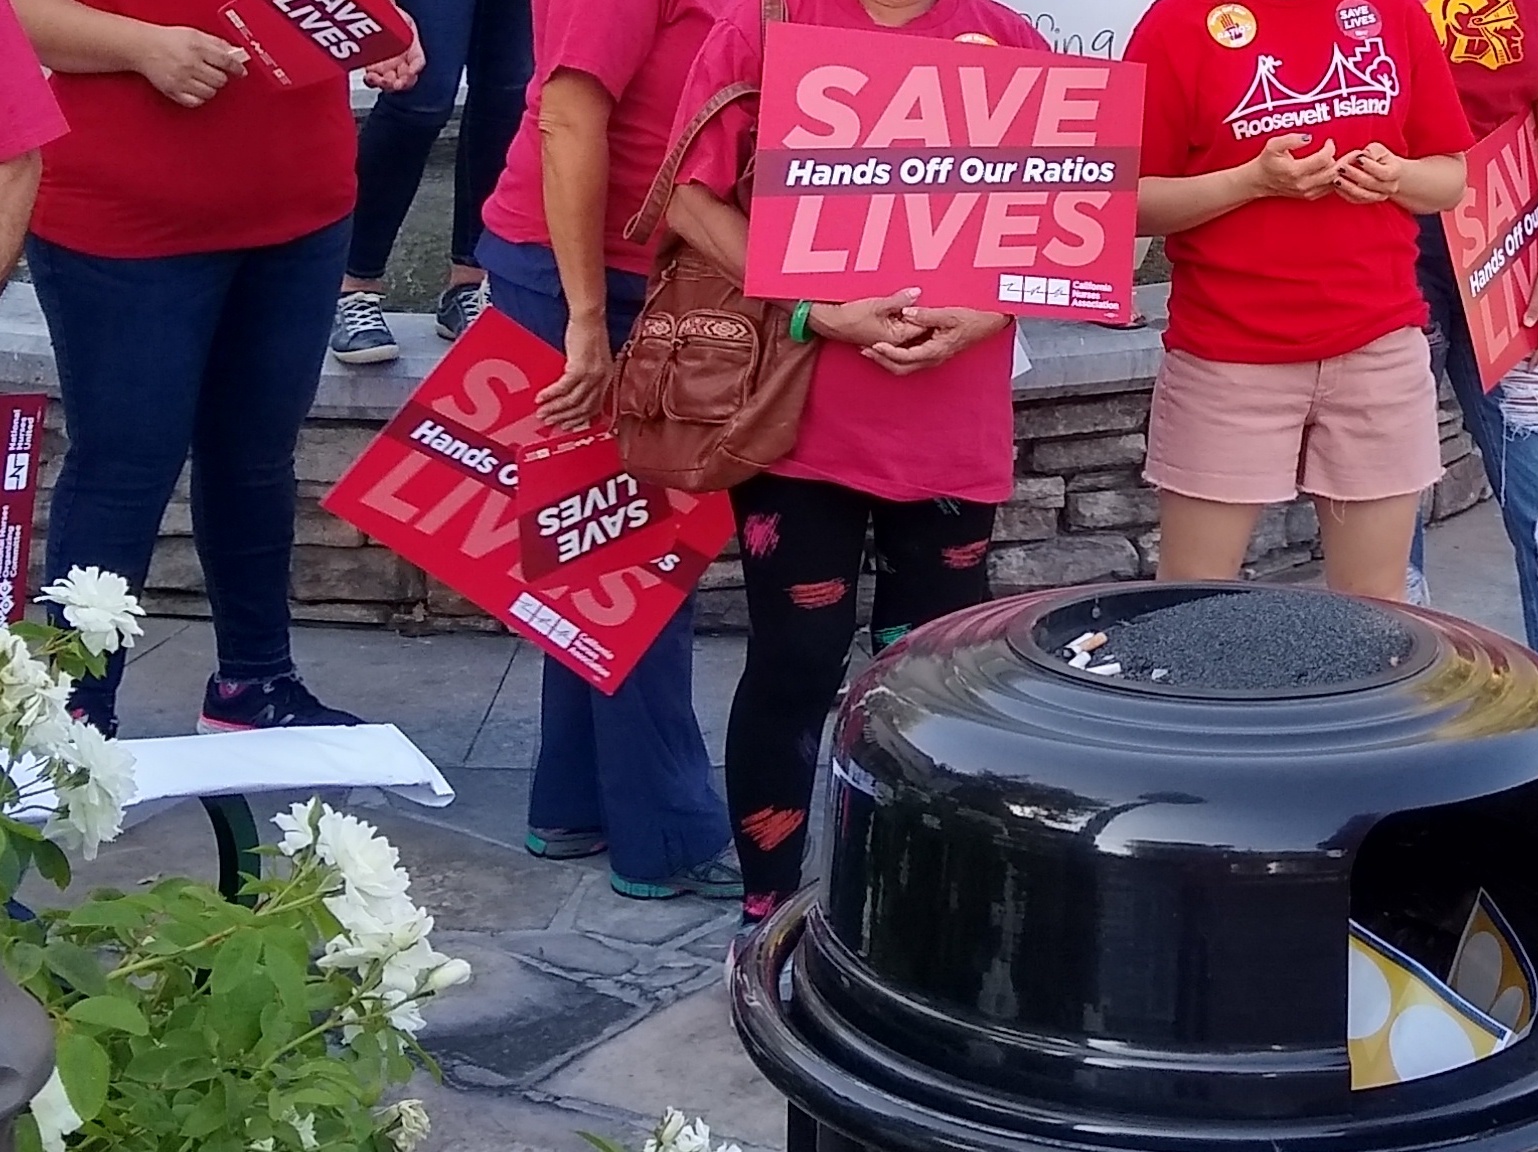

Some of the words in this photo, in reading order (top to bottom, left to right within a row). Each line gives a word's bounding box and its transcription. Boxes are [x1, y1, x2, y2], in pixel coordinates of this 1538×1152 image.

[1339, 4, 1370, 21] SAVE
[1343, 13, 1377, 31] LIVES
[781, 65, 1111, 149] SAVE
[1231, 101, 1331, 141] Roosevelt
[1333, 93, 1390, 117] Island
[785, 157, 892, 187] Hands
[899, 156, 955, 185] Off
[959, 158, 1019, 184] Our
[1022, 155, 1116, 184] Ratios
[780, 190, 1113, 275] LIVES
[1468, 246, 1506, 299] Hands
[1503, 219, 1525, 259] Off
[410, 419, 499, 474] Hands
[537, 473, 638, 537] LIVES
[556, 499, 649, 563] SAVE
[358, 449, 662, 627] LIVS
